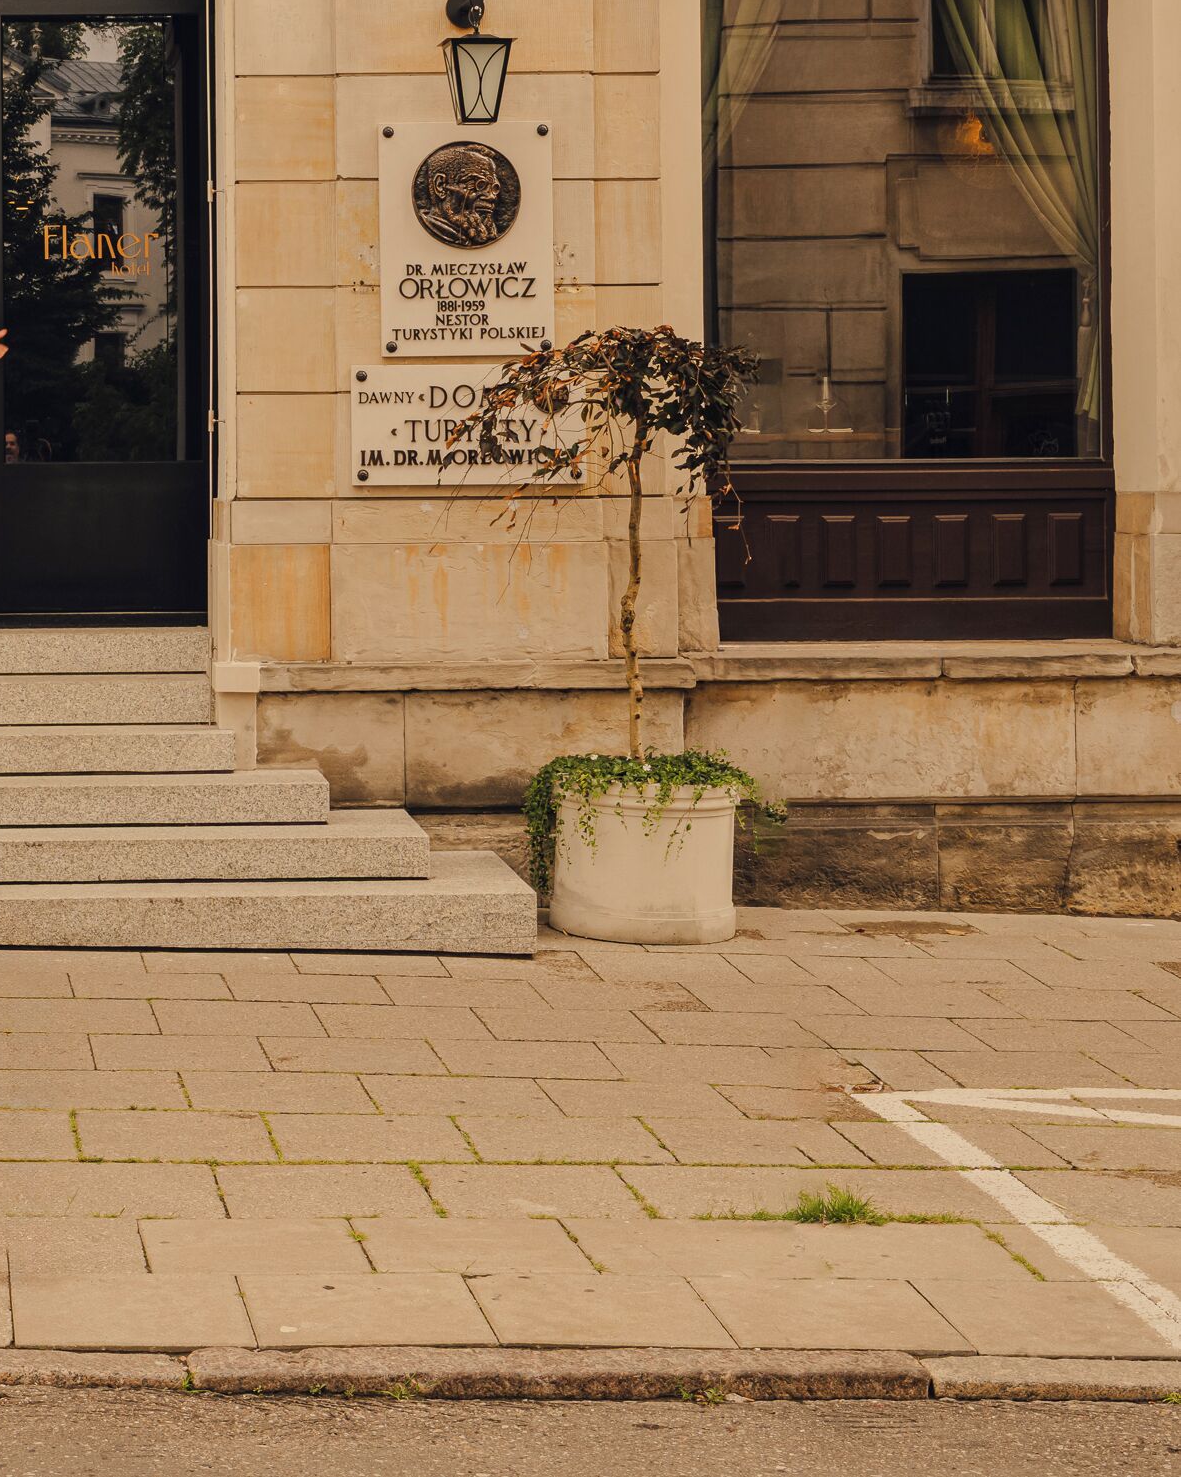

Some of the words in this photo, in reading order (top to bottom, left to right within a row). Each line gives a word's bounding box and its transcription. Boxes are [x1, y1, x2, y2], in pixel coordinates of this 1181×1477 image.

[43, 224, 159, 260] Flaner
[111, 261, 150, 276] hotel
[406, 264, 426, 276] DR.
[431, 262, 528, 275] MIECZYSŁAW
[399, 276, 536, 300] ORŁOWICZ
[435, 313, 489, 326] NESTOR
[392, 327, 473, 341] TURYSTYKI
[480, 326, 545, 339] POLSKIEJ
[358, 391, 415, 404] DAWNY
[405, 419, 537, 443] TURYTY
